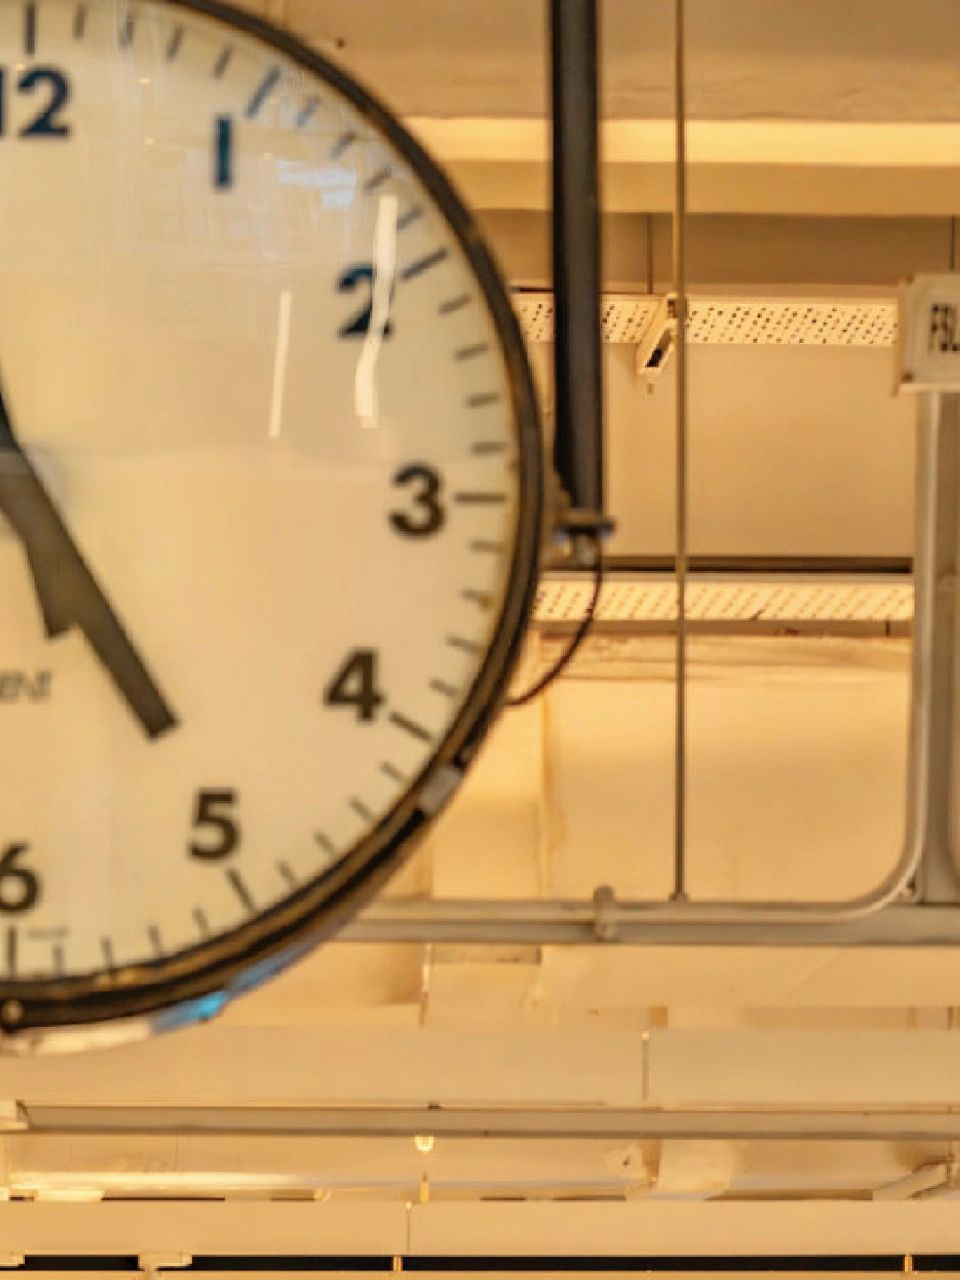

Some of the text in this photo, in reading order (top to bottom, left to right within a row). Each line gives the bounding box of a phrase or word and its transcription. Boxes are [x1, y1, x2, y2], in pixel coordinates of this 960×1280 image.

[213, 115, 234, 190] 1
[336, 262, 393, 338] 2
[388, 462, 446, 540] 3
[325, 649, 385, 723] 4
[187, 788, 240, 861] 5
